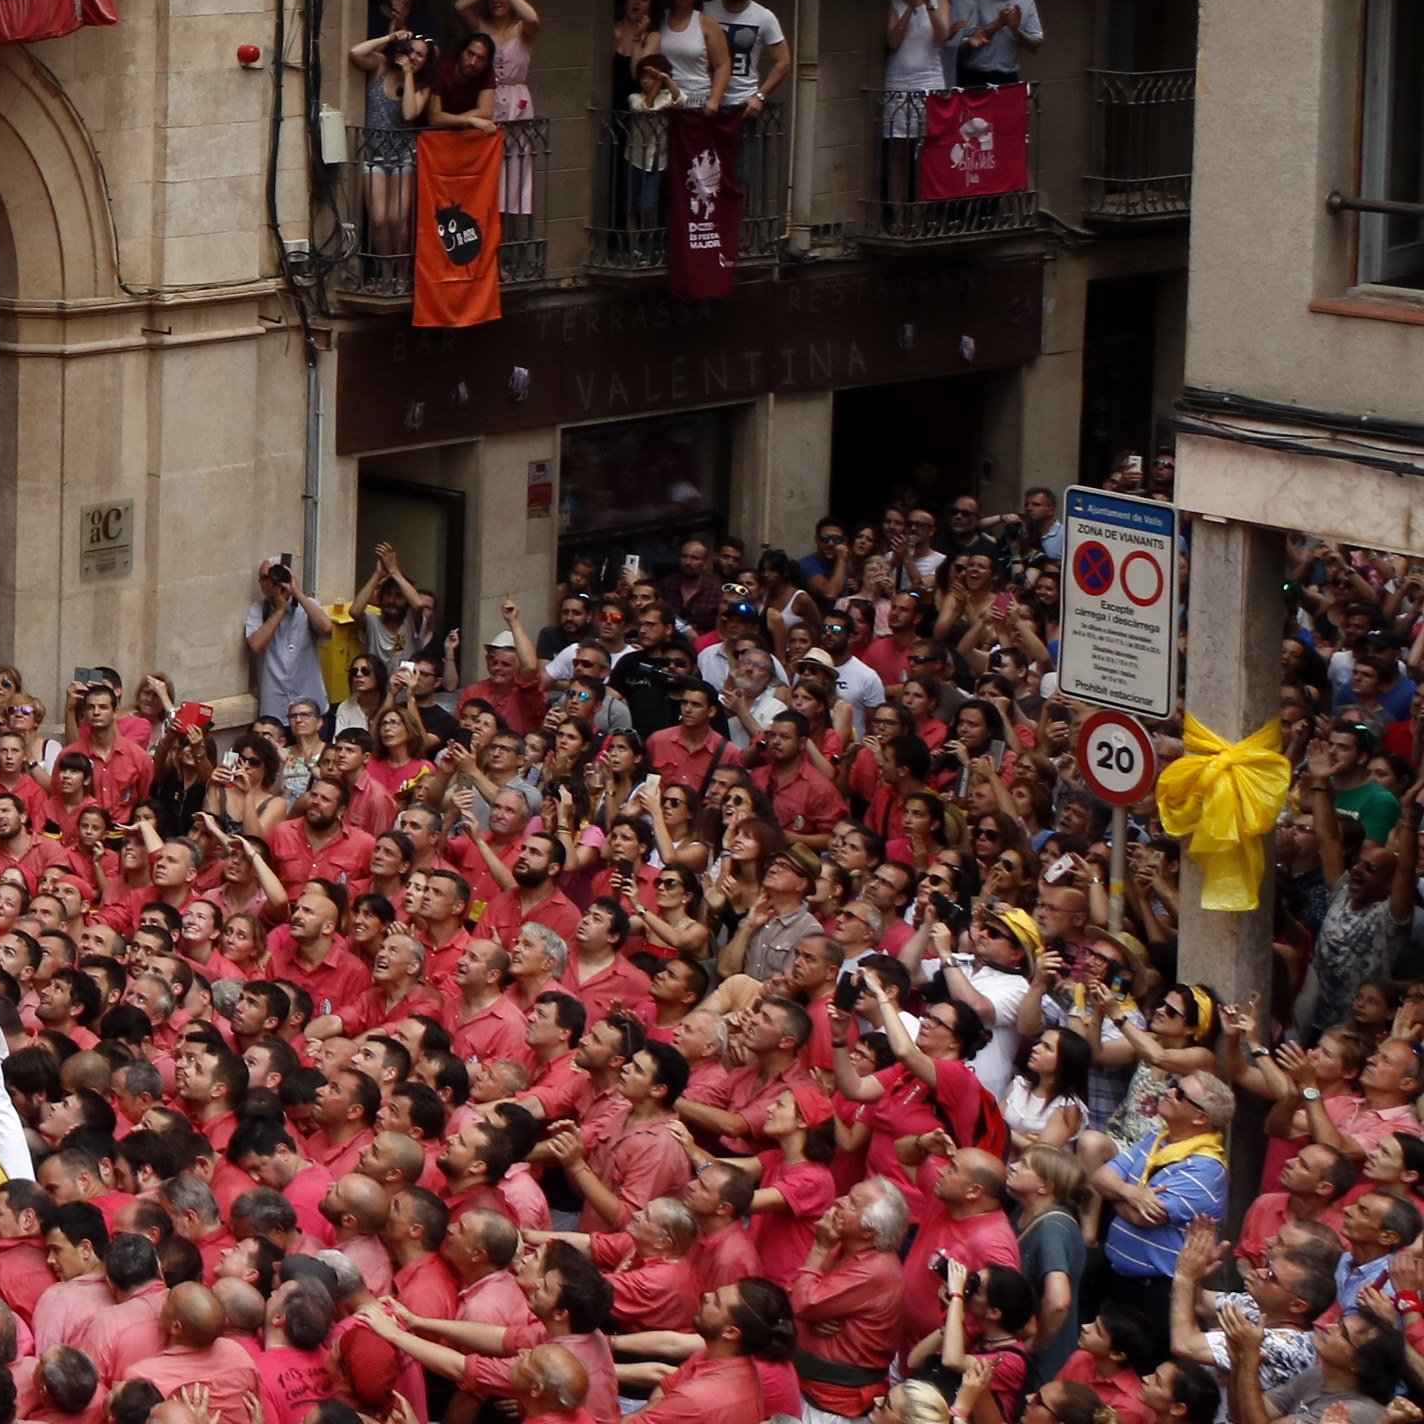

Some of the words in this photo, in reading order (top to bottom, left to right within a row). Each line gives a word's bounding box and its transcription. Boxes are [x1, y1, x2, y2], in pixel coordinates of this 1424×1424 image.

[690, 240, 722, 249] MAJOR
[392, 329, 457, 362] BAR
[538, 298, 716, 344] TERRASSA
[575, 342, 869, 412] VALENTINA
[1087, 505, 1131, 522] Ajuntament
[1132, 513, 1142, 522] de
[1144, 515, 1162, 527] Valls
[1078, 523, 1103, 538] ZONA
[1106, 530, 1117, 540] DE
[1119, 532, 1164, 550] VIANANTS
[1101, 601, 1134, 616] Excepte
[1075, 680, 1108, 695] Prohibit
[1109, 689, 1153, 706] estacionar
[1095, 740, 1135, 775] 20
